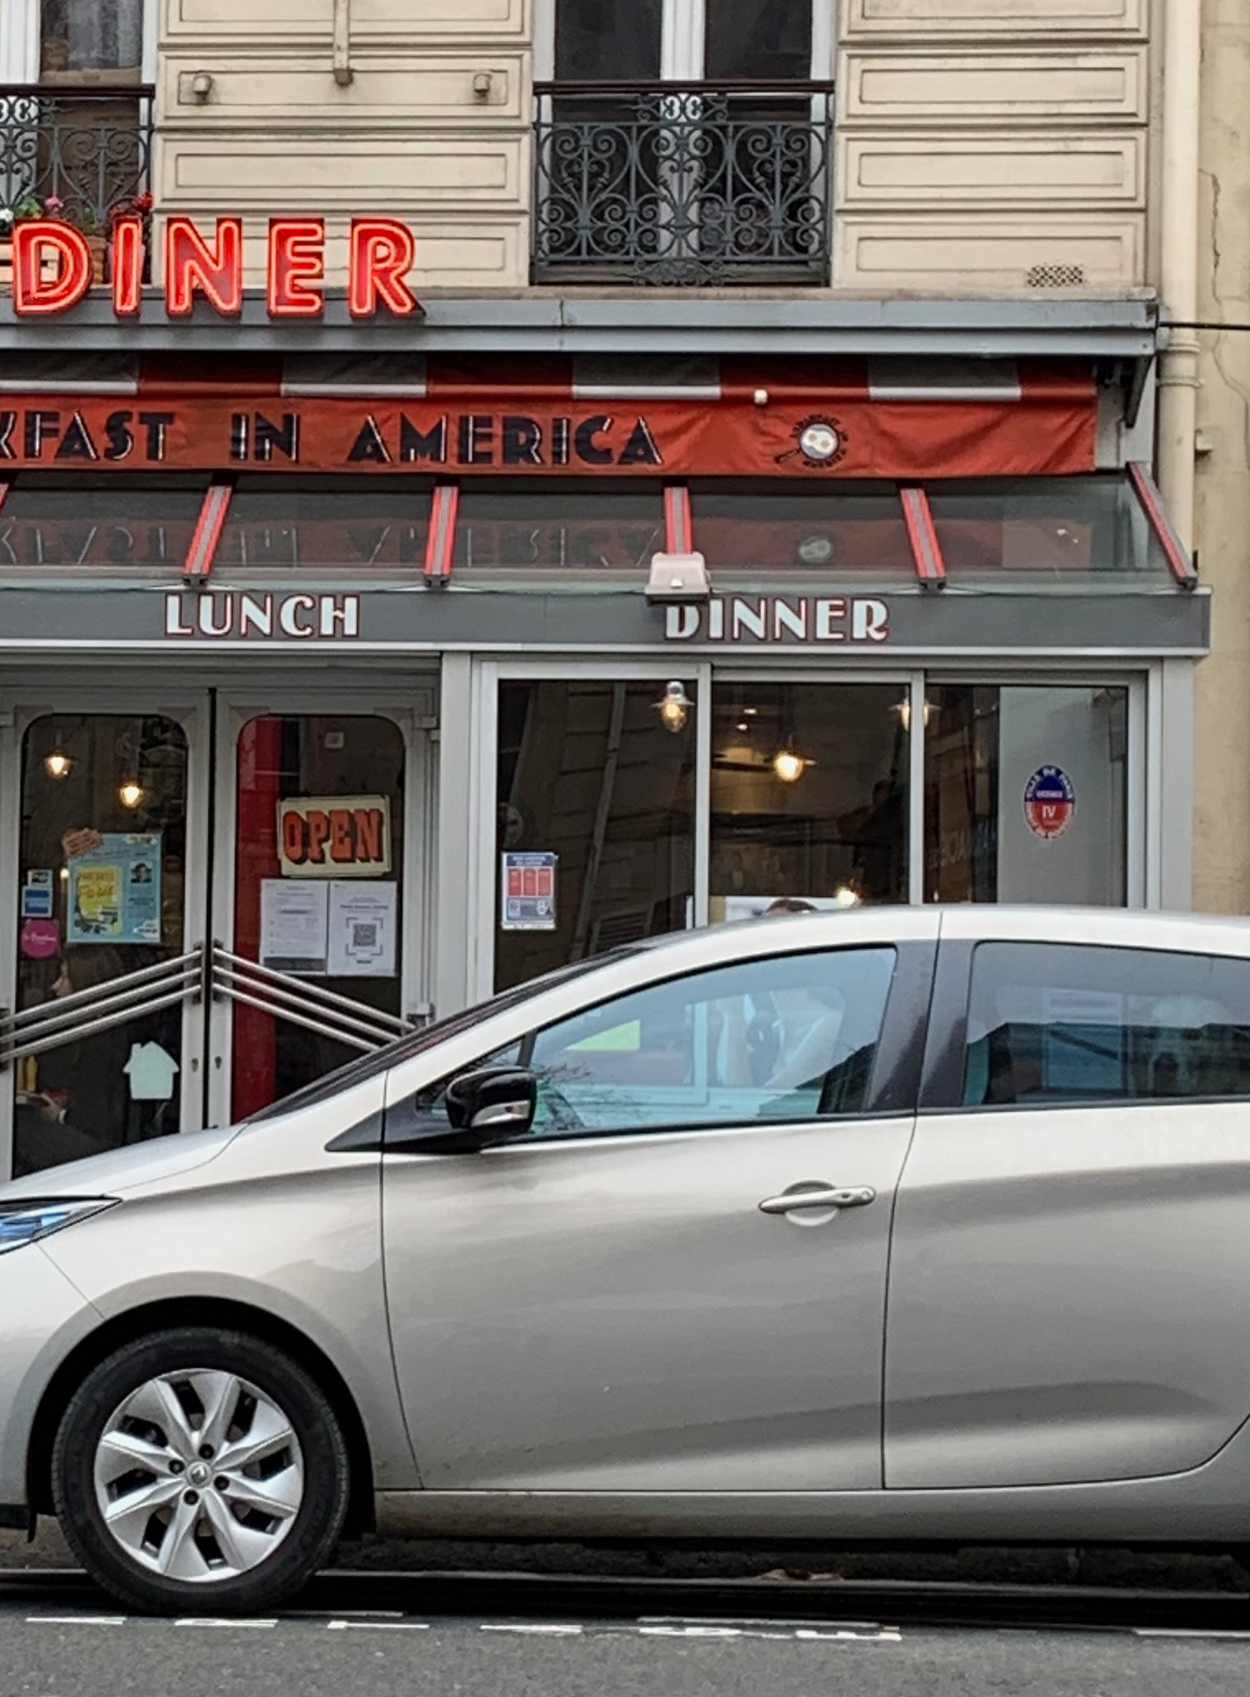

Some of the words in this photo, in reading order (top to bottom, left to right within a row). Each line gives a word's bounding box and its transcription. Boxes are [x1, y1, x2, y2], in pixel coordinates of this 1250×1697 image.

[12, 217, 425, 317] DINER
[230, 412, 300, 461] IN
[347, 413, 663, 466] AMERICA
[164, 593, 360, 638] LUNCH
[664, 597, 890, 641] DINNER
[282, 808, 385, 864] OPEN
[1042, 805, 1057, 818] IV
